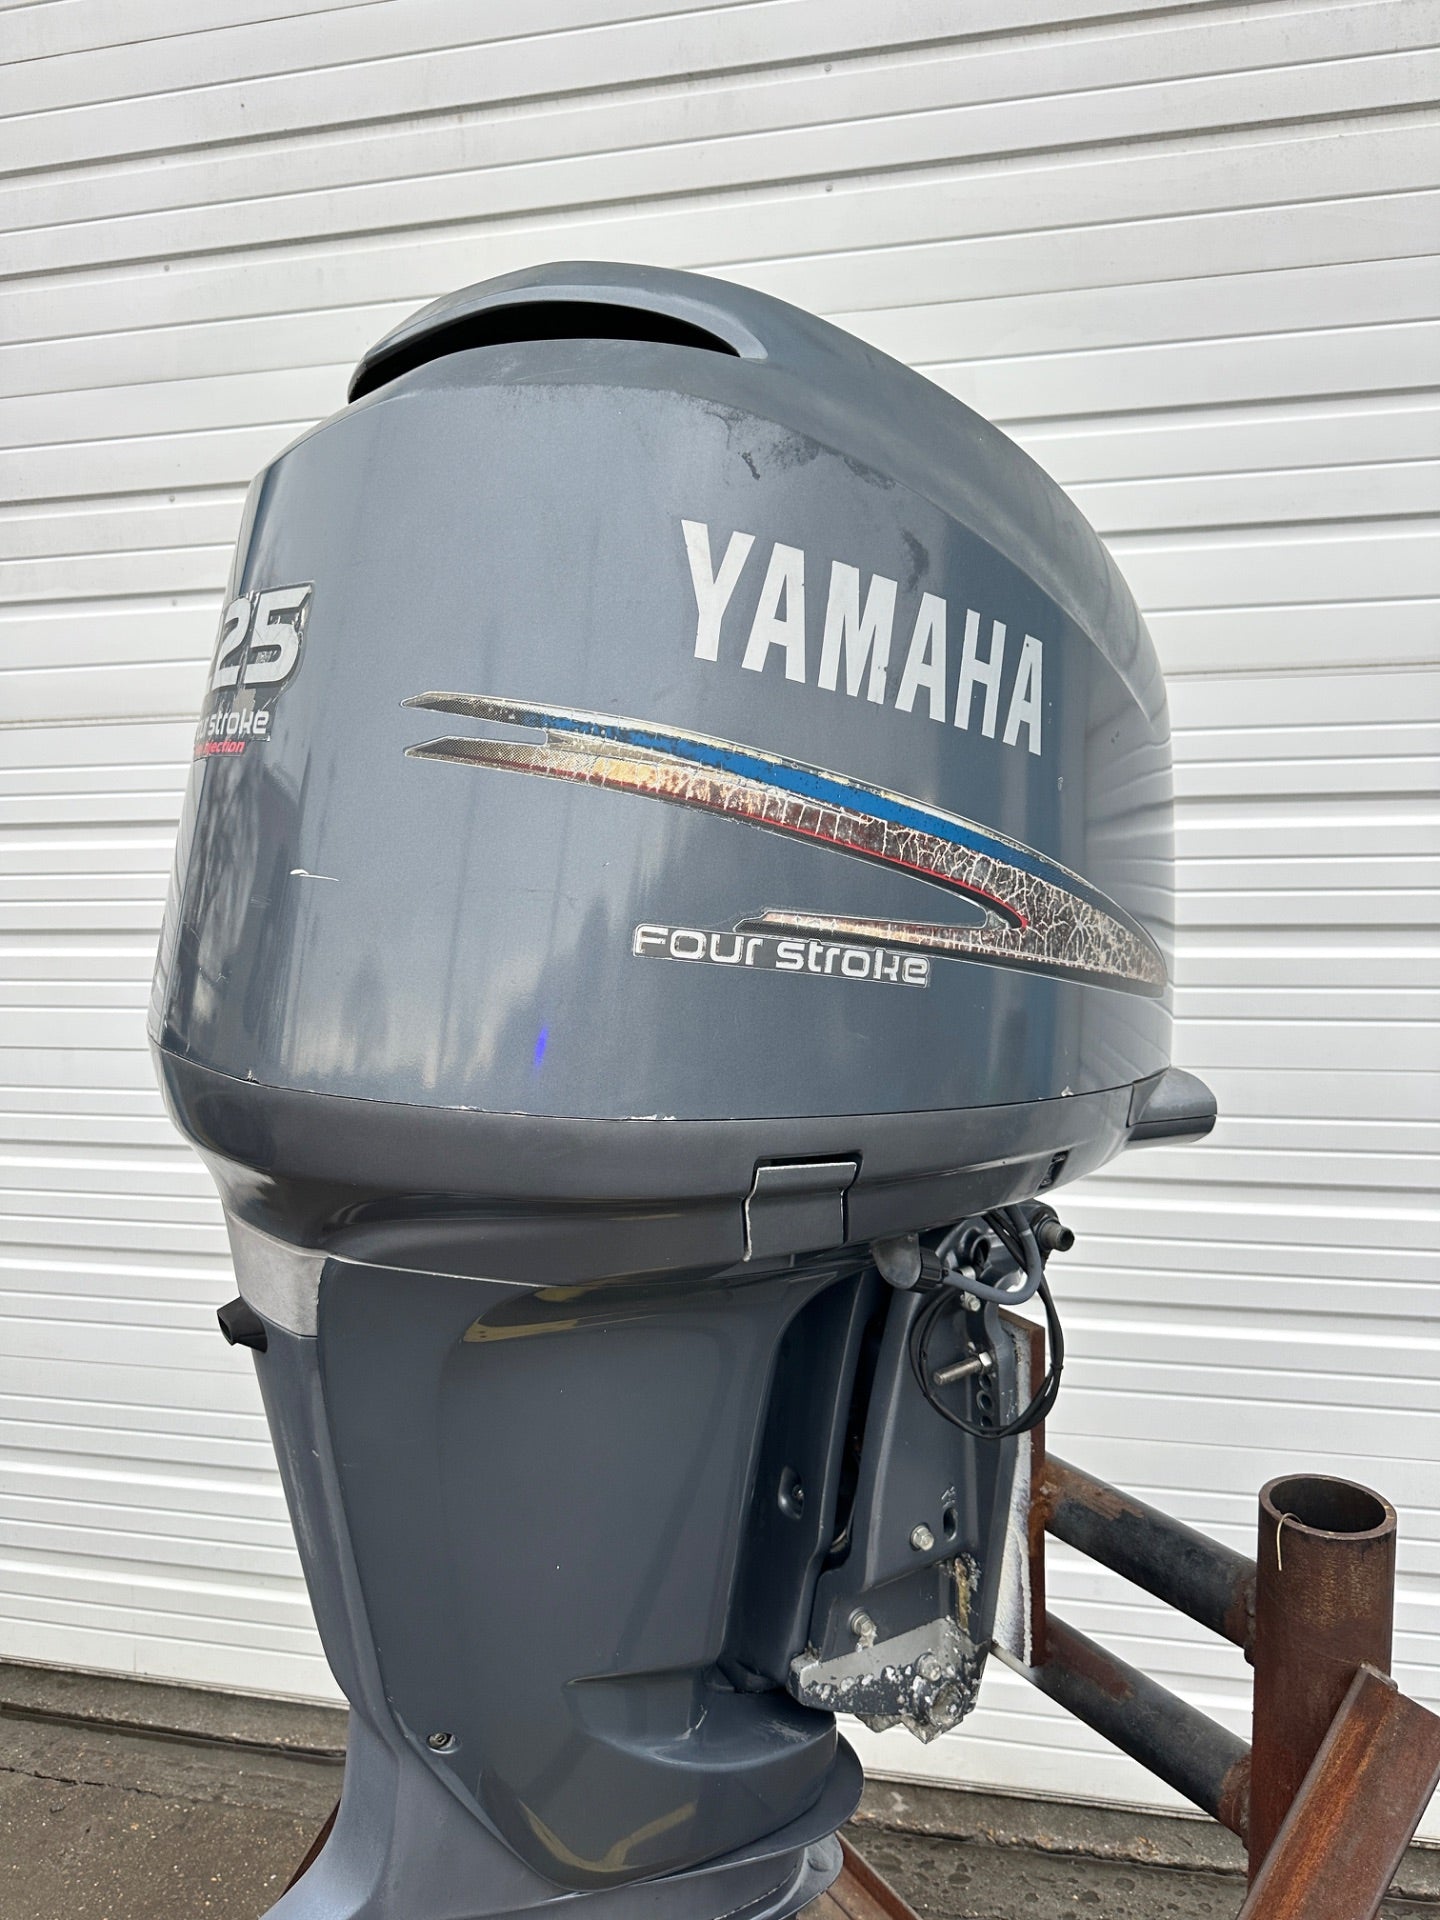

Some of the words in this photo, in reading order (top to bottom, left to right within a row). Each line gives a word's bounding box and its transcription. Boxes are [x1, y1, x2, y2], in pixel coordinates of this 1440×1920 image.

[681, 520, 1043, 756] YAMAHA
[208, 708, 269, 736] stroke
[775, 942, 928, 984] stroke
